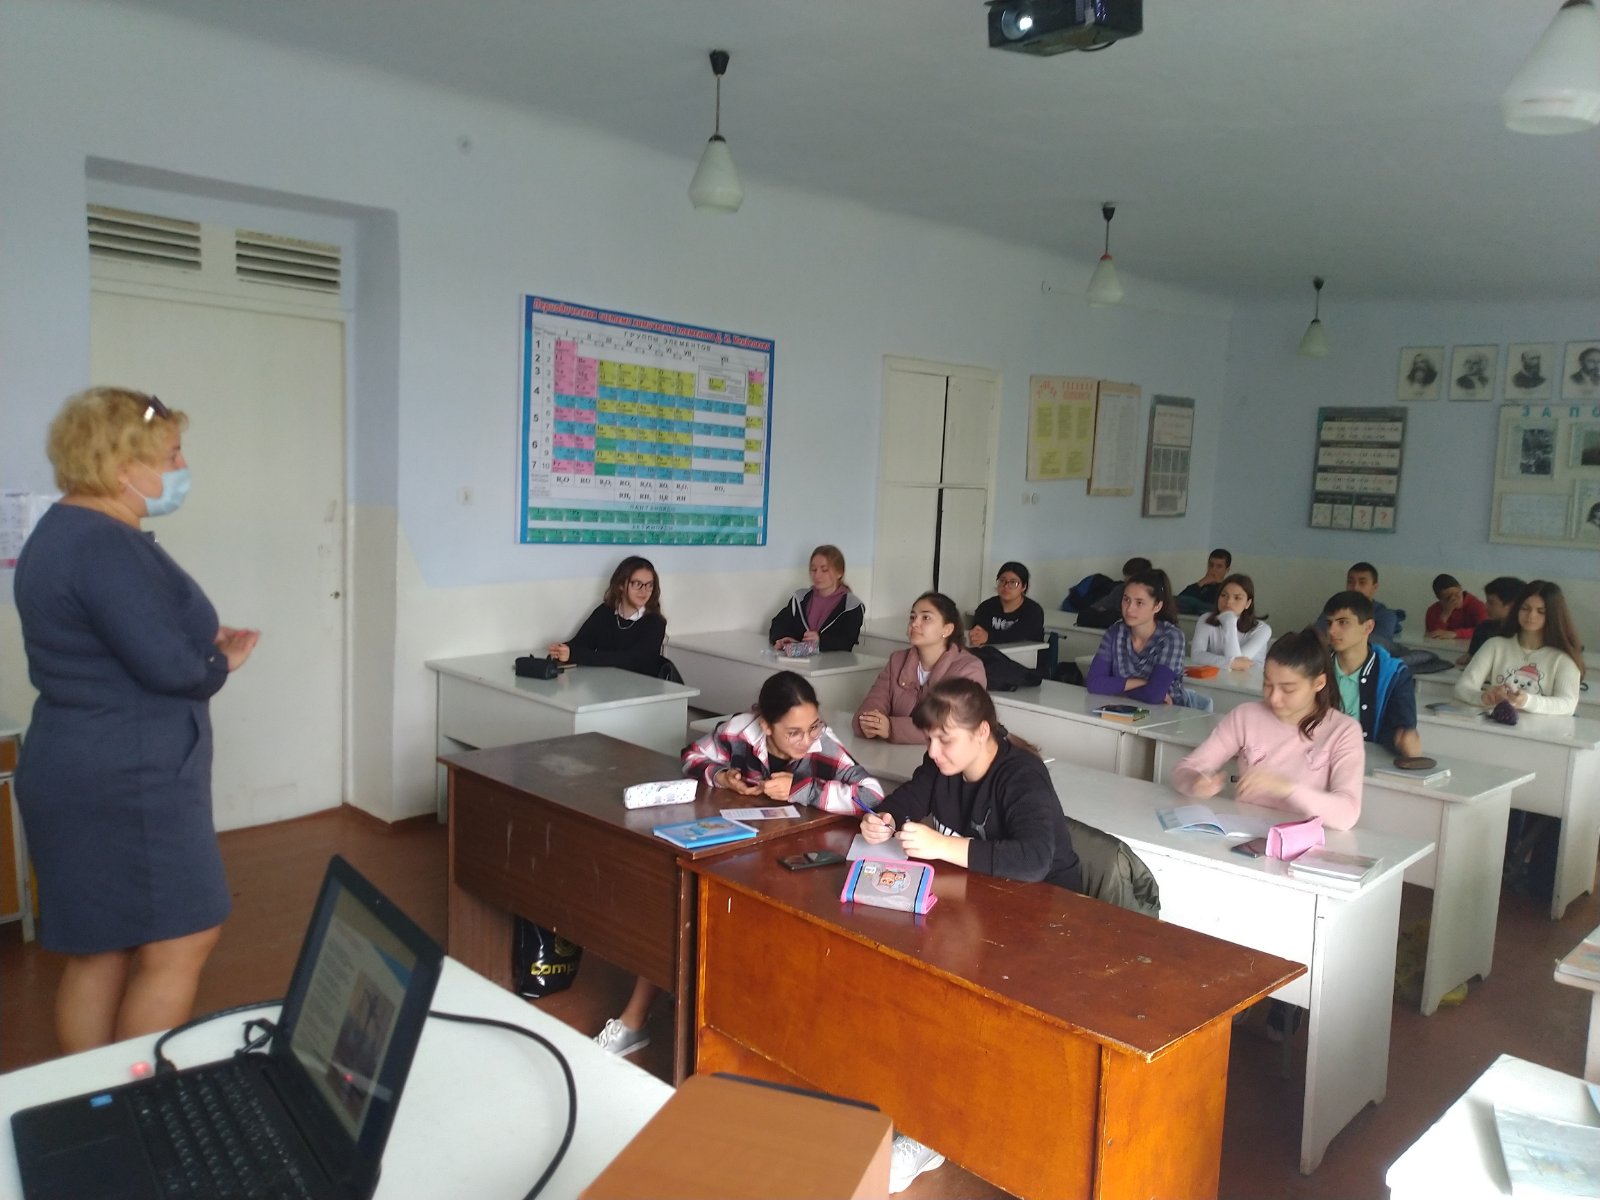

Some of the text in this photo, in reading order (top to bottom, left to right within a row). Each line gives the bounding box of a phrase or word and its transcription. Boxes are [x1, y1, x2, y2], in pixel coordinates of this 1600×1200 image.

[536, 340, 541, 349] 1
[535, 354, 541, 363] 2
[535, 367, 541, 376] 3
[534, 386, 541, 395] 4
[533, 413, 540, 423] 5
[532, 440, 538, 450] 6
[532, 461, 538, 470] 7
